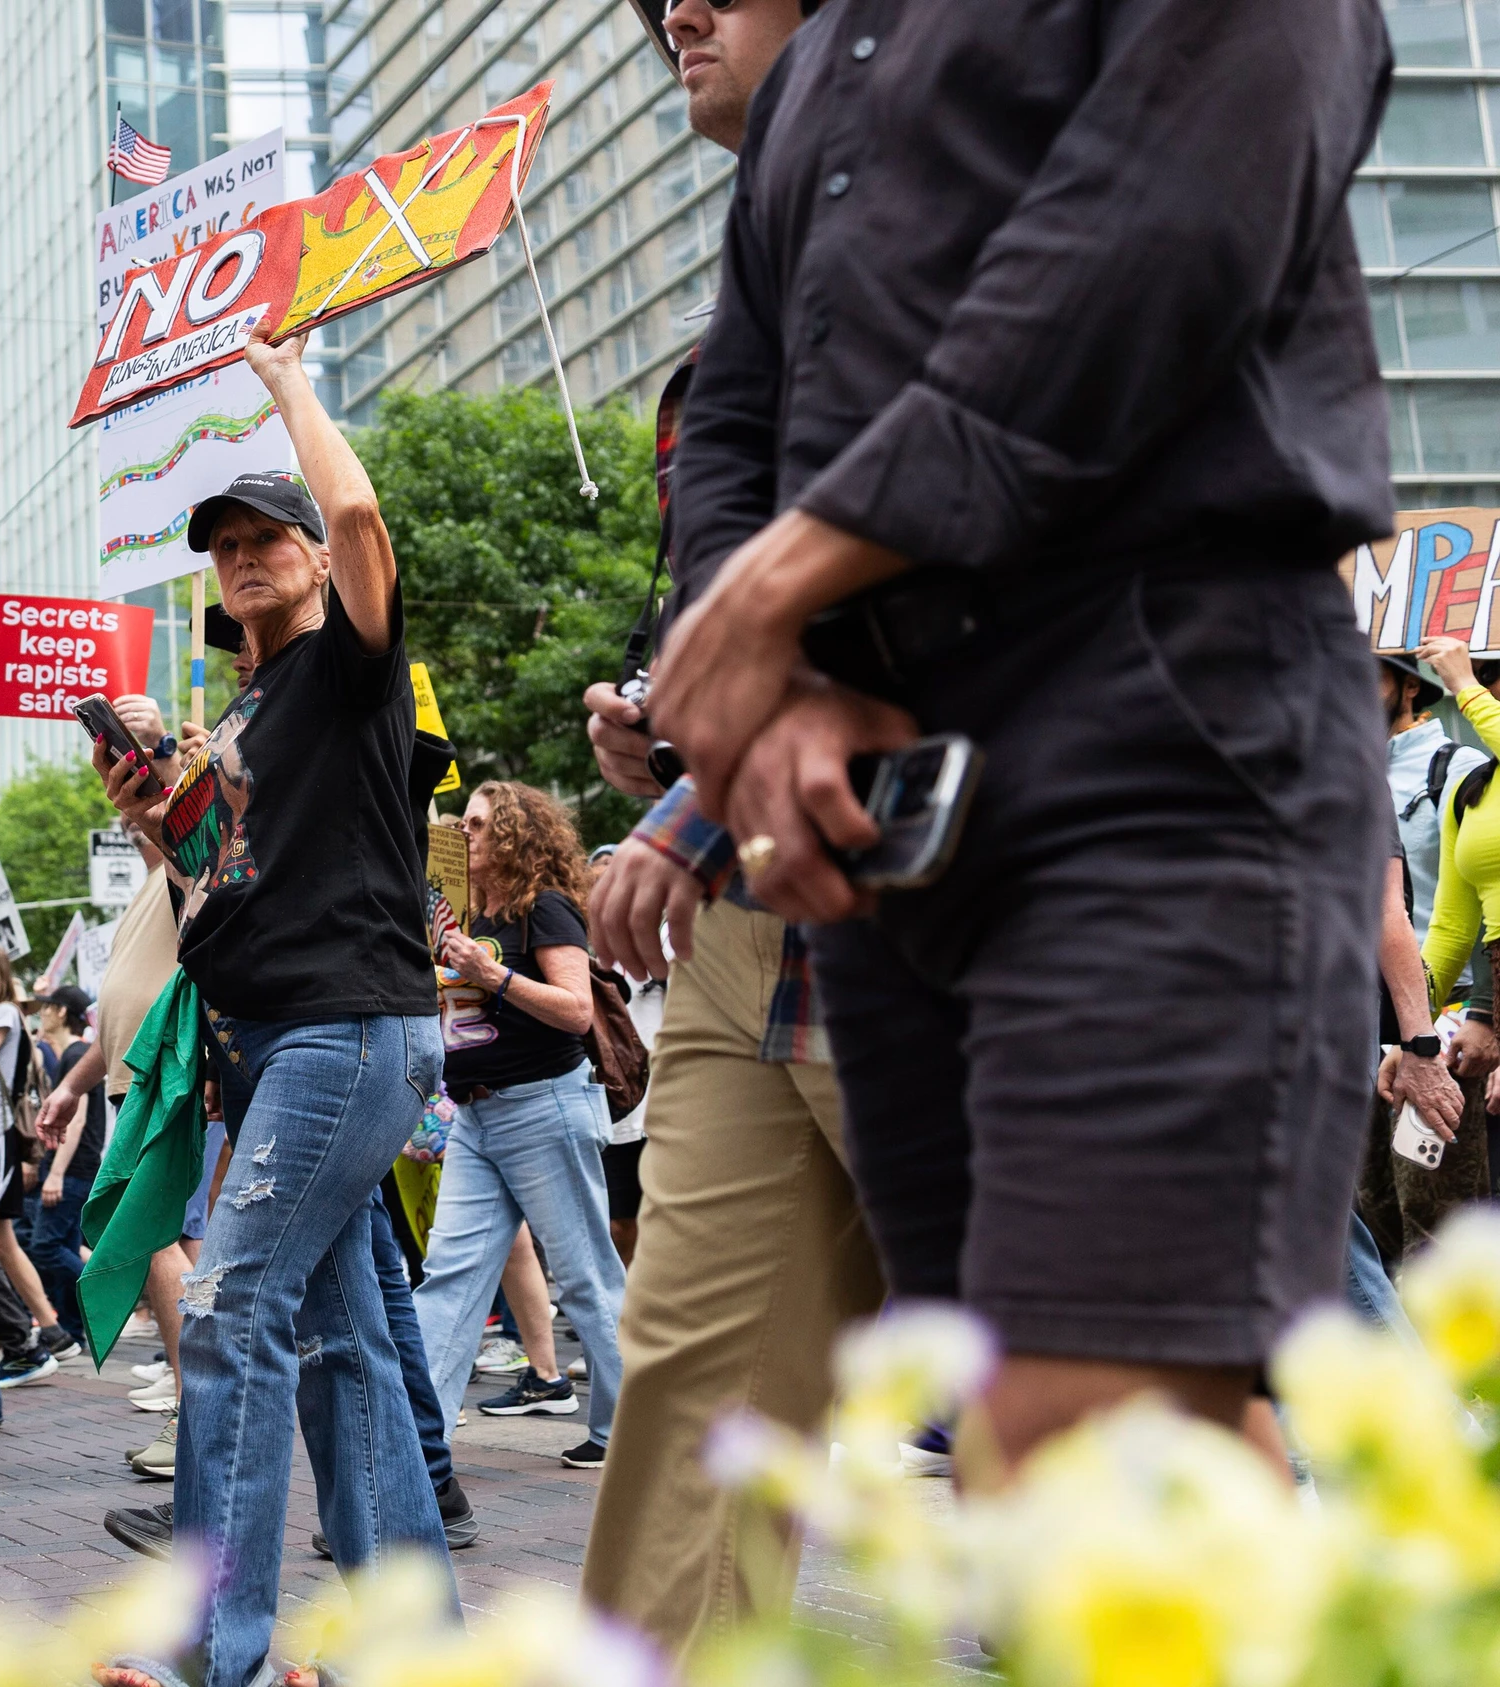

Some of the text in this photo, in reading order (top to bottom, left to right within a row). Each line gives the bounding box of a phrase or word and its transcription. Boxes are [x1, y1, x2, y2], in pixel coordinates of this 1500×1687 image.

[100, 185, 197, 262] AMERICA
[205, 168, 235, 198] WAS
[242, 150, 276, 181] NOT
[97, 230, 267, 368] NO
[2, 600, 119, 632] Secrets
[19, 629, 96, 664] keep
[5, 658, 108, 690] rapists
[18, 688, 82, 714] safe
[166, 772, 215, 843] THROUGH
